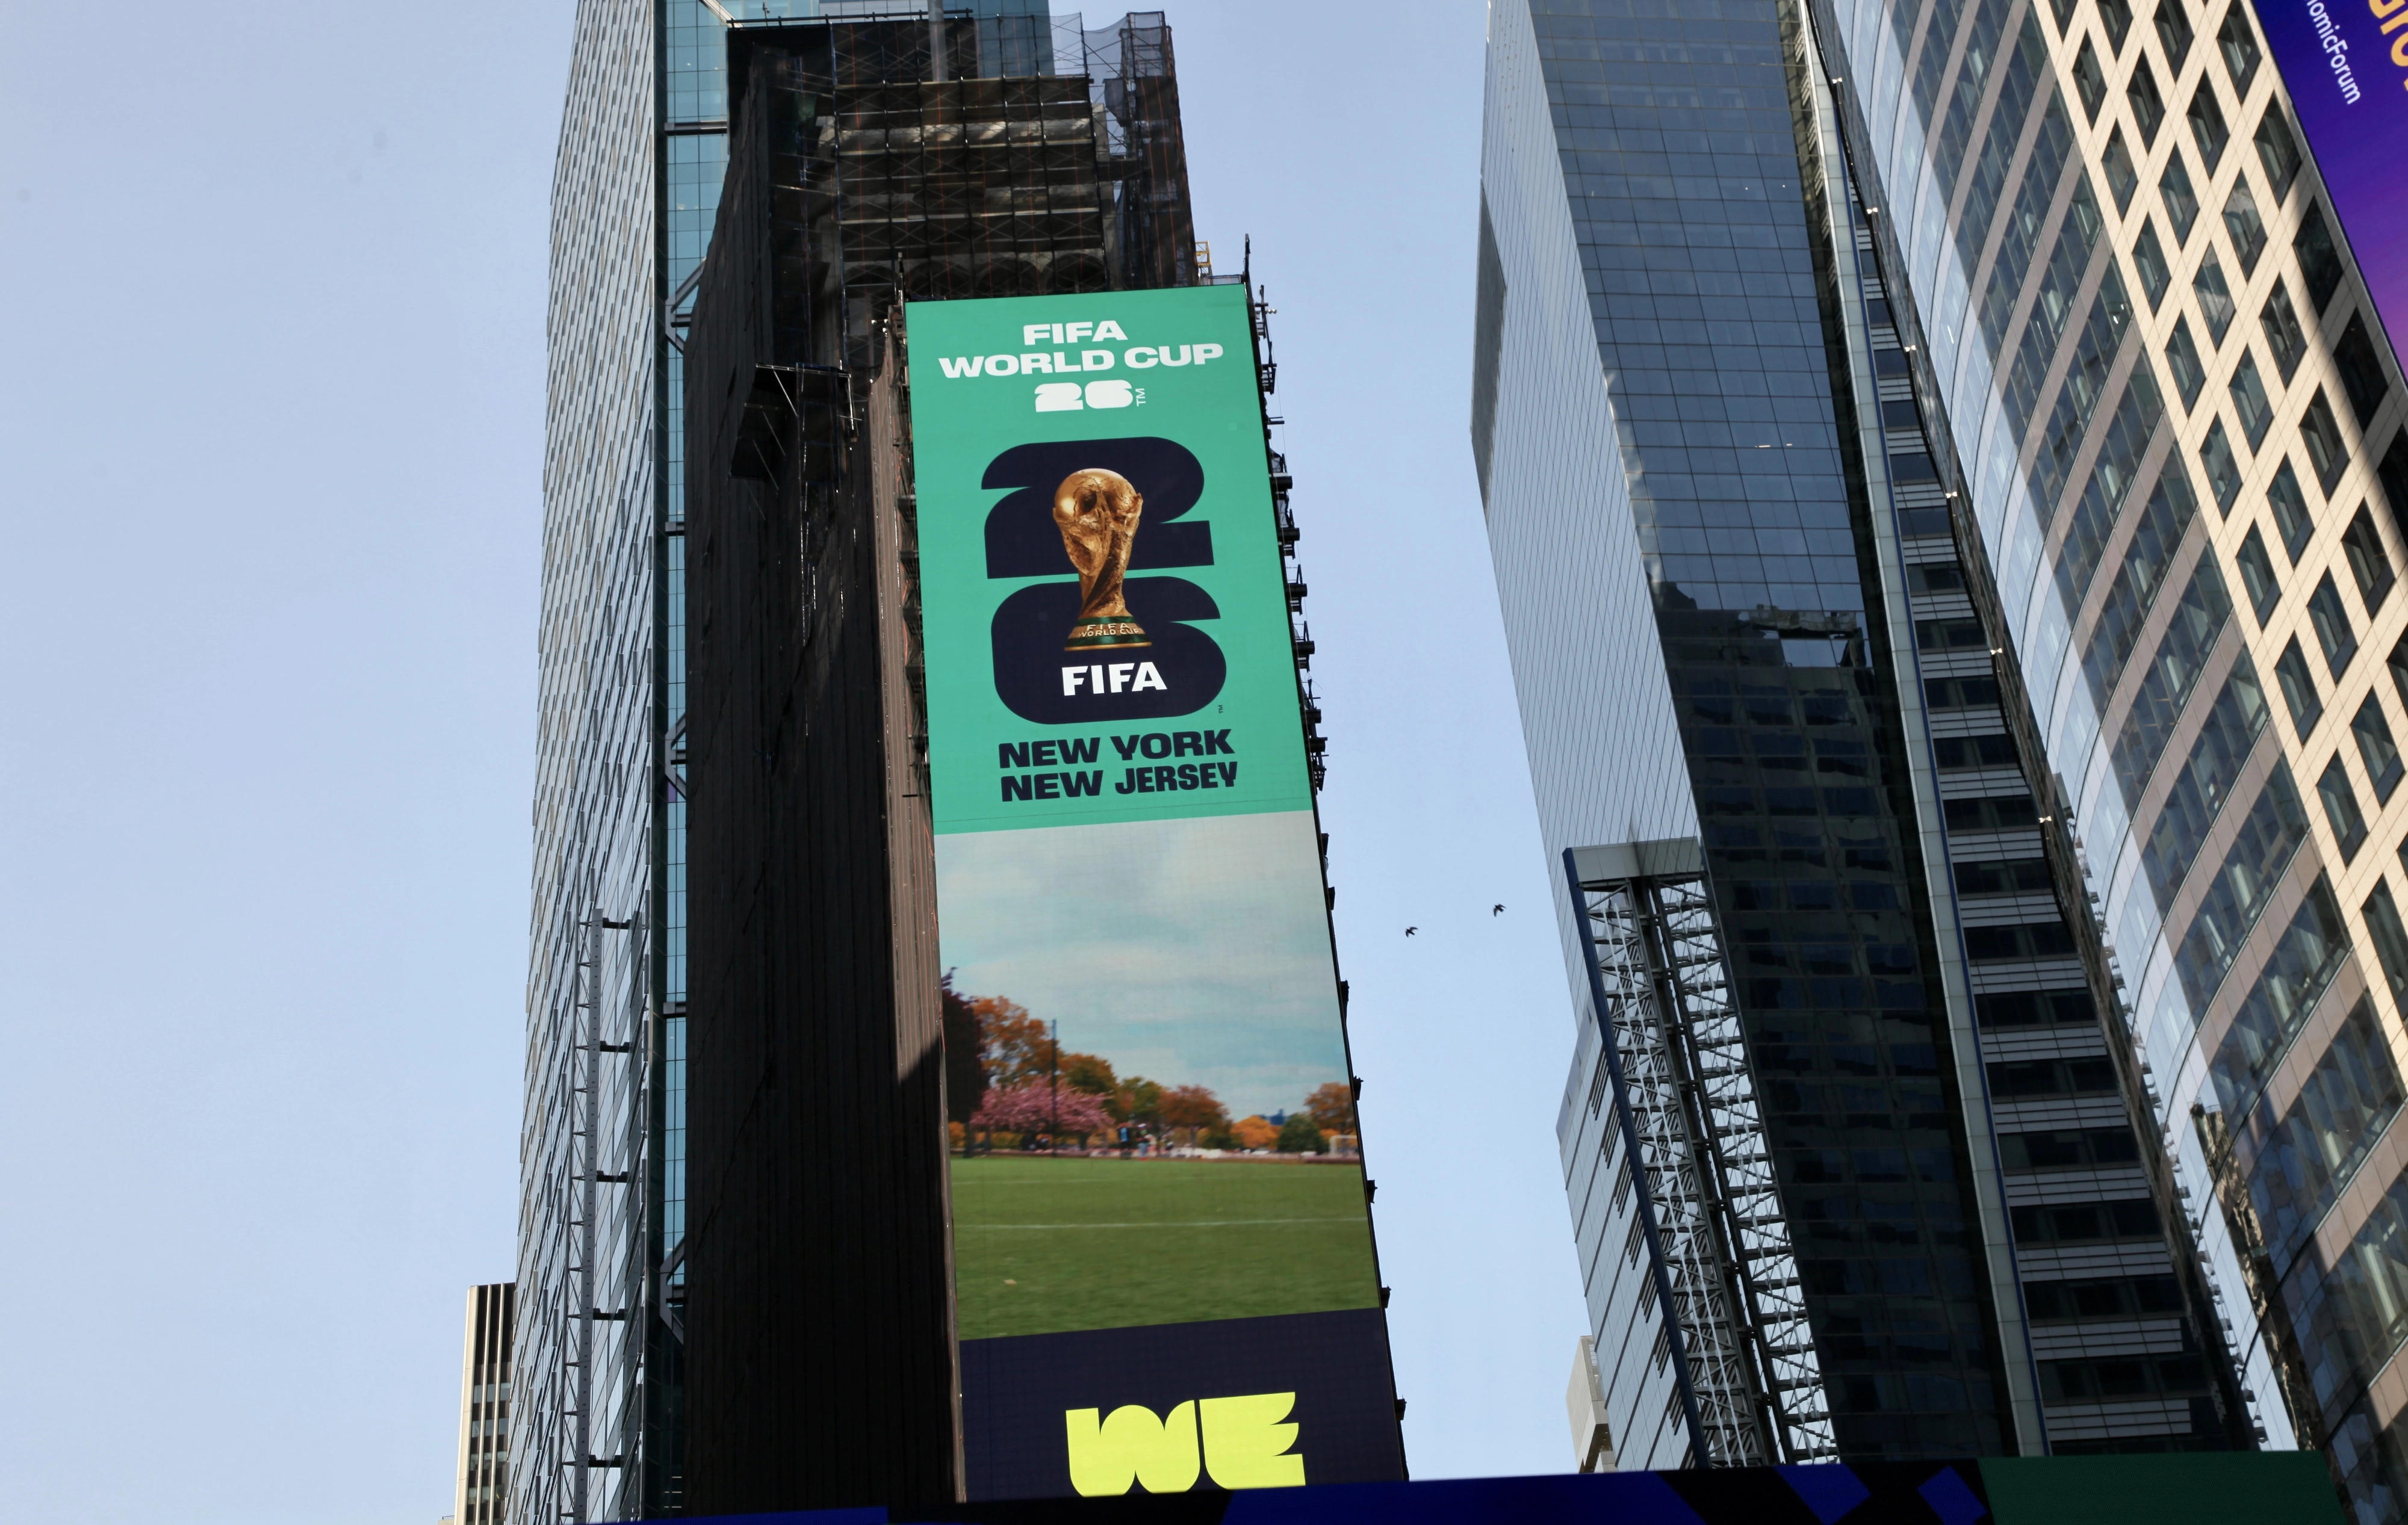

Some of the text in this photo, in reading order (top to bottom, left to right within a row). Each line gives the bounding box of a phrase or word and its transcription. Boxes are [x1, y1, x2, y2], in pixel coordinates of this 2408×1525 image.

[1023, 320, 1128, 345] FIFA
[938, 343, 1224, 379] WORLD CUP
[1034, 379, 1146, 412] 26 TM
[1086, 622, 1131, 631] FIFA
[1061, 661, 1168, 696] FIFA
[998, 729, 1235, 769] NEW YORK
[1001, 761, 1238, 802] NEW JERSEY
[1066, 1391, 1306, 1497] WE
